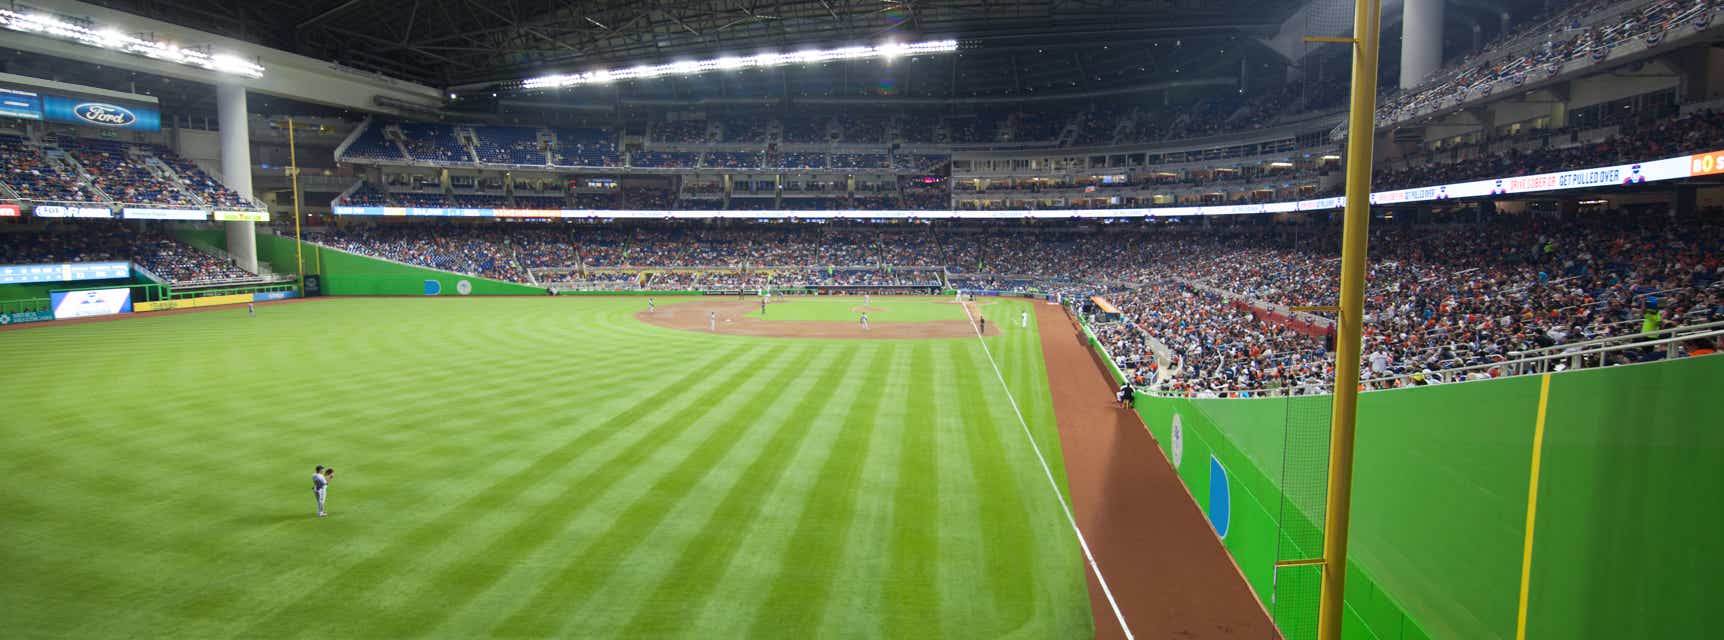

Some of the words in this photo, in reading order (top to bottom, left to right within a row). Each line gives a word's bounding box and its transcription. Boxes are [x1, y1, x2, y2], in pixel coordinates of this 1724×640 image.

[85, 105, 125, 124] Ford
[1559, 174, 1572, 186] GET
[1572, 171, 1598, 185] PULLED
[1599, 169, 1620, 183] OVER
